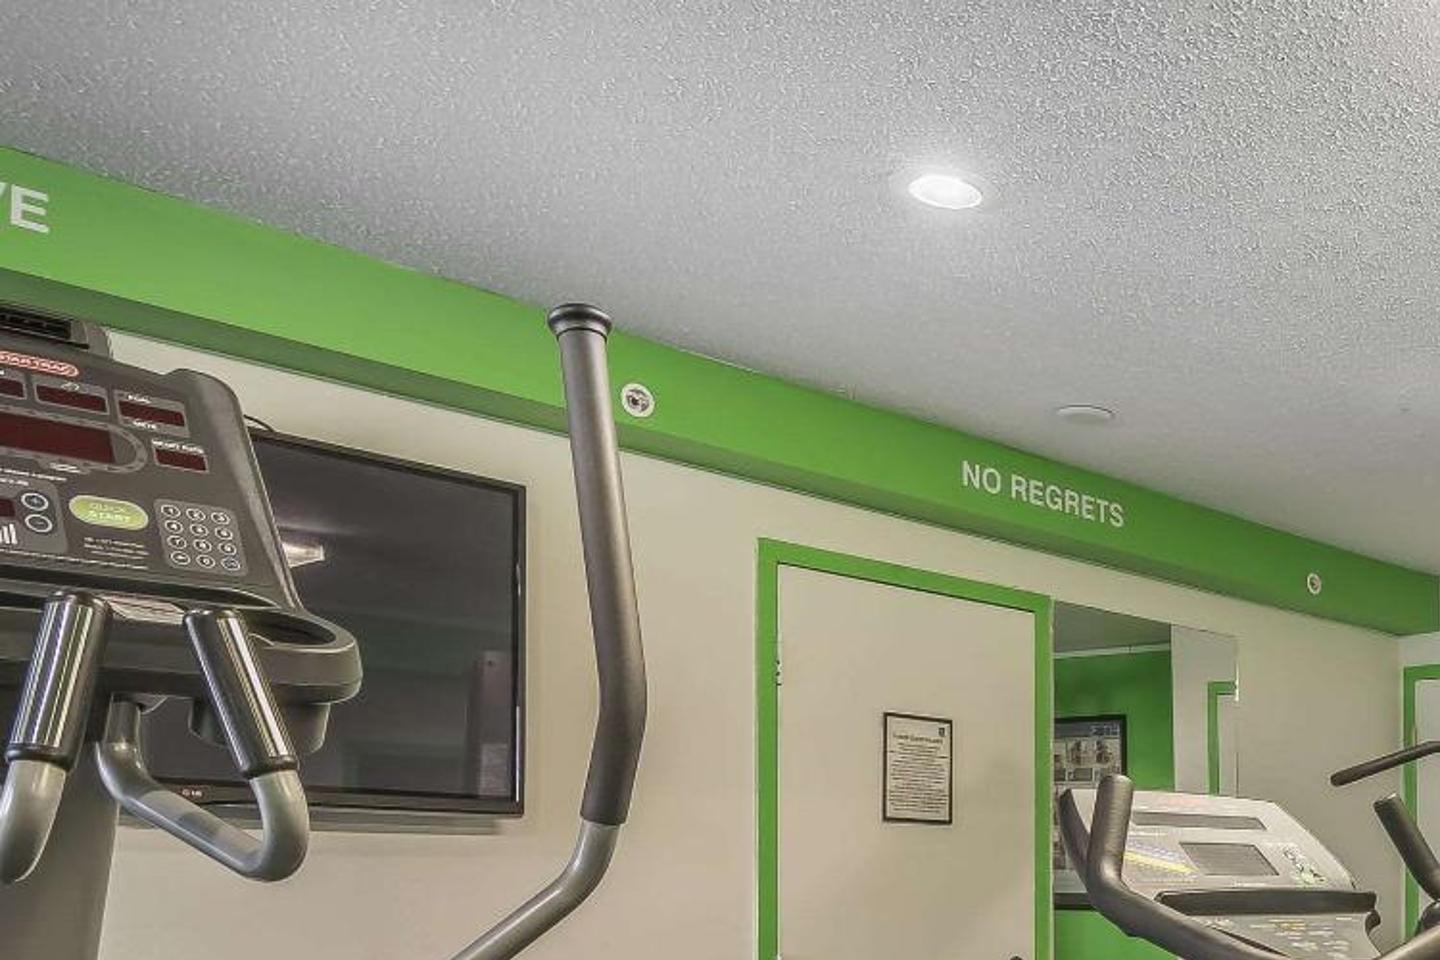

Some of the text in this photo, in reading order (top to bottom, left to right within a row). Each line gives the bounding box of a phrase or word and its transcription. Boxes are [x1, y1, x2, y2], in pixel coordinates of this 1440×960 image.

[0, 182, 49, 233] E
[962, 460, 1124, 527] NO REGRETS
